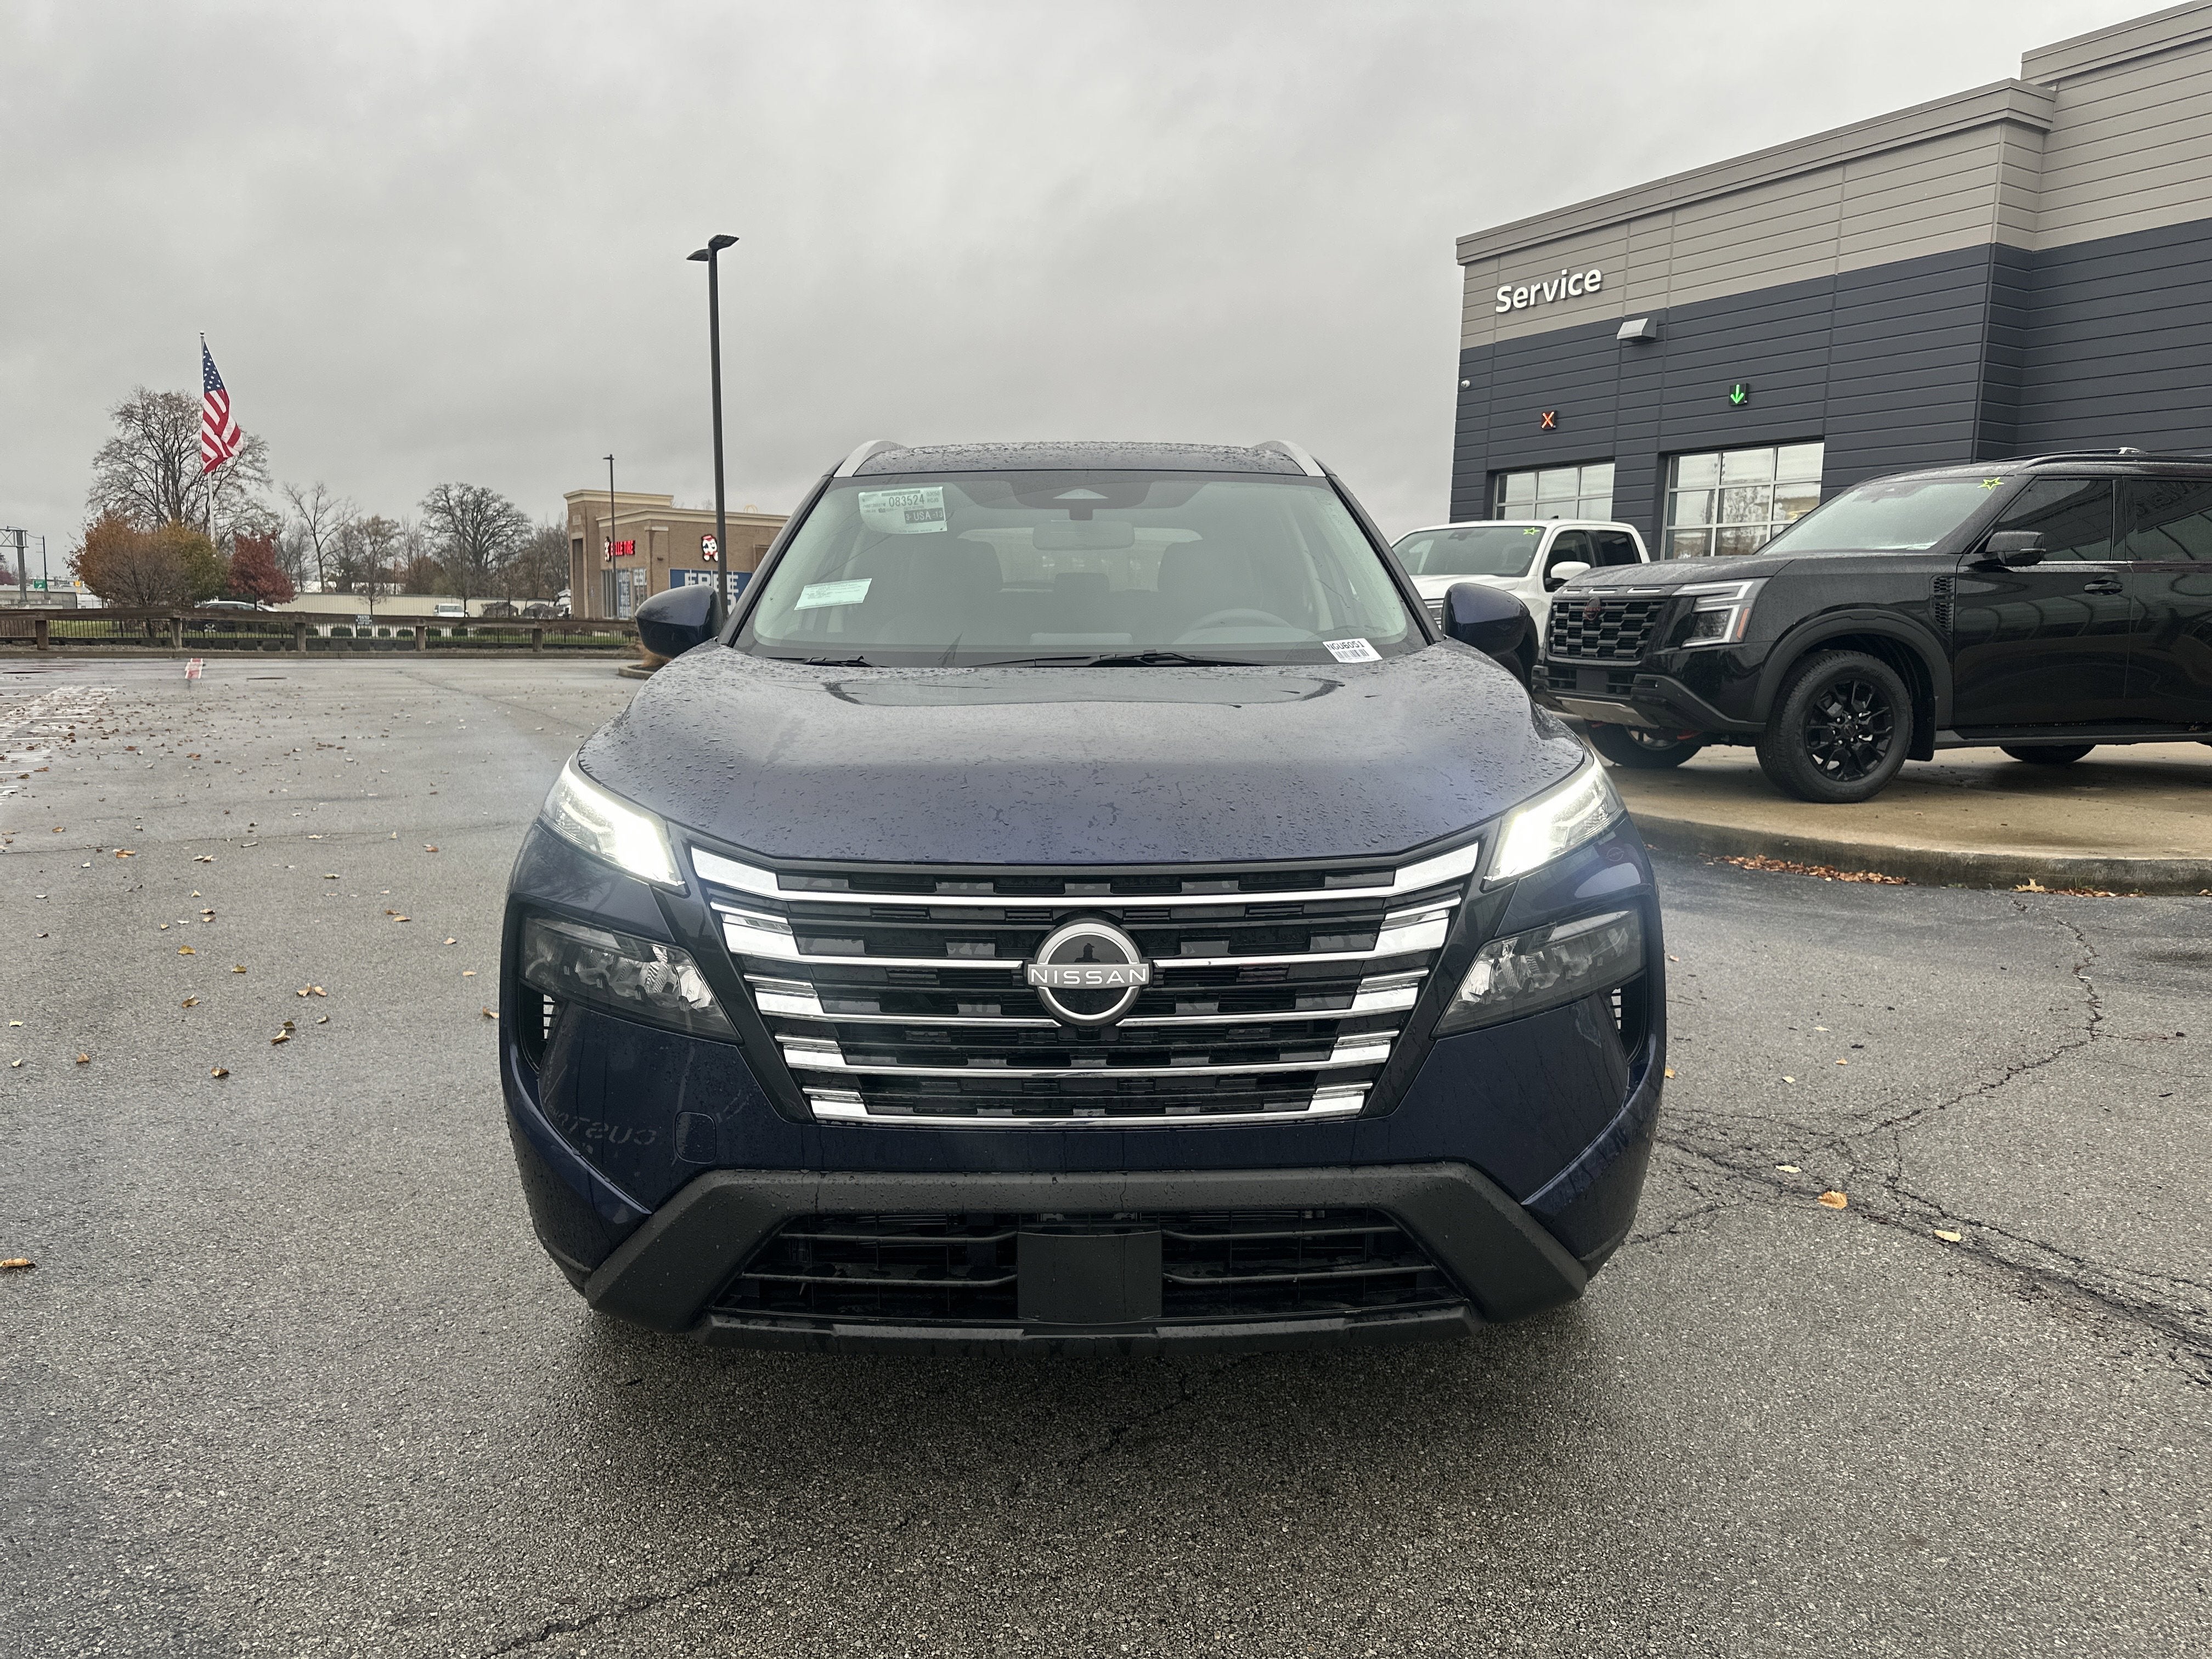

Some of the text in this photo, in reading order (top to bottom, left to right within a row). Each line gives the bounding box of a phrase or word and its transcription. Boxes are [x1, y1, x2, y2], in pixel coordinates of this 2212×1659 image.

[1496, 269, 1602, 313] Service
[889, 494, 925, 507] 083524
[913, 512, 932, 521] USA
[1326, 640, 1365, 650] NGU6051
[1031, 968, 1146, 984] NISSAN
